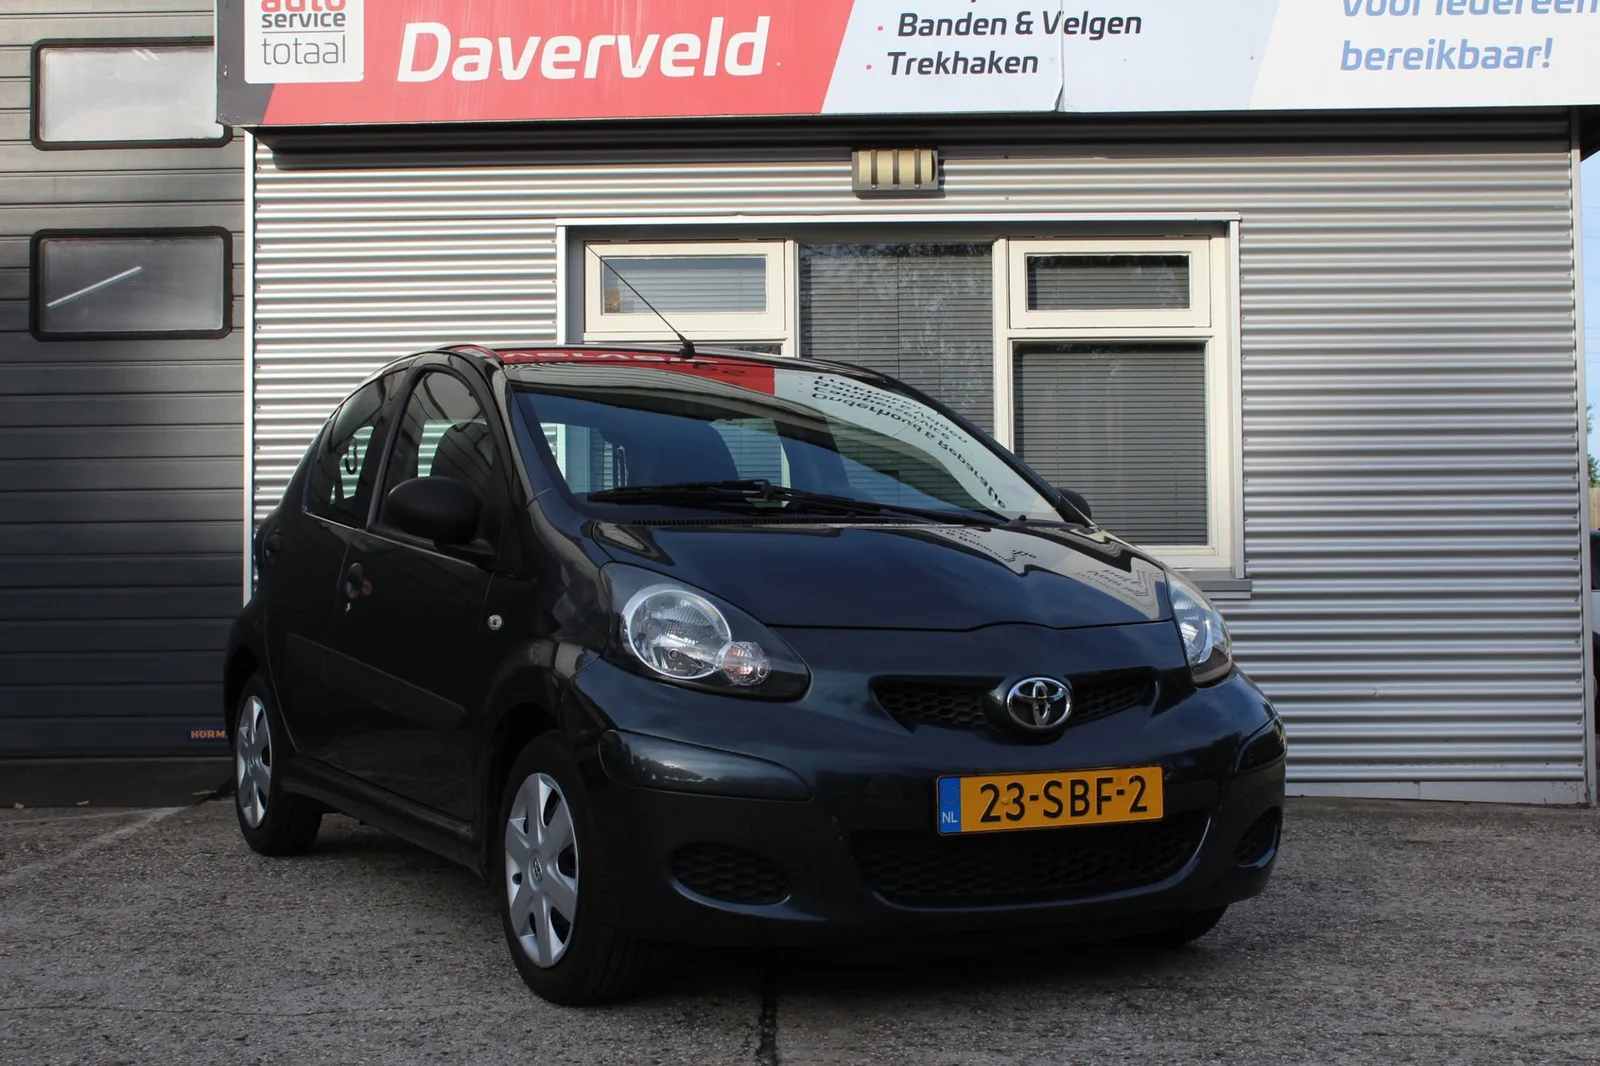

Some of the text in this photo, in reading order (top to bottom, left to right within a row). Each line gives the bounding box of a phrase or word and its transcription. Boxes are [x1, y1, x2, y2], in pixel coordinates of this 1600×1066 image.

[261, 12, 346, 28] service
[898, 10, 1143, 41] Banden & Velgen
[261, 34, 346, 65] totaal
[397, 16, 771, 82] Daverveld
[887, 50, 1039, 76] Trekhaken
[1340, 38, 1554, 71] bereikbaar!
[190, 729, 228, 739] HORM
[980, 774, 1148, 823] 23-SBF-2
[941, 811, 959, 824] NL
